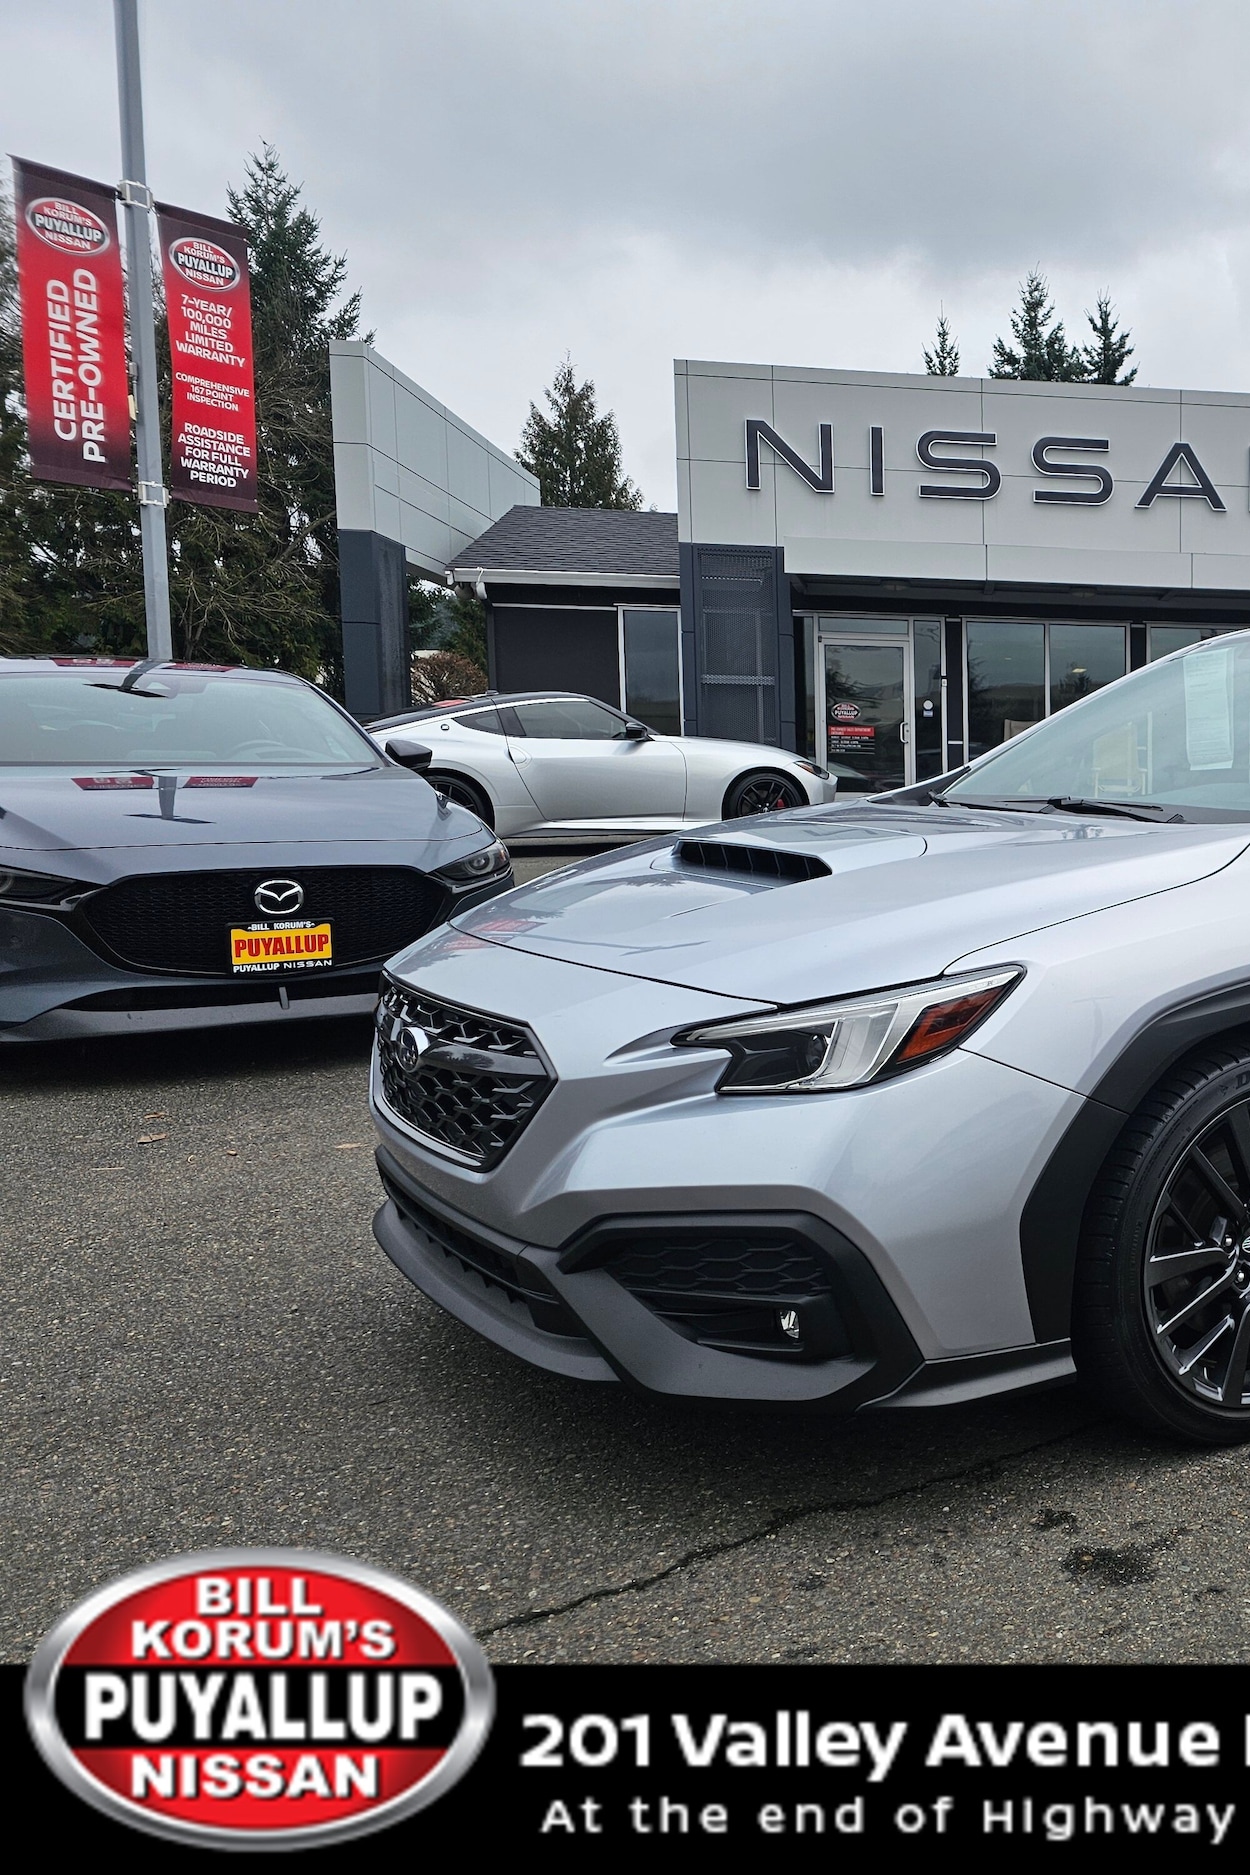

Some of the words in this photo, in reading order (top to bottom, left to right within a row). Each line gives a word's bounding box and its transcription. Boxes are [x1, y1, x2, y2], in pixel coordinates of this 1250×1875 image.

[43, 207, 92, 226] KORUM'S
[54, 201, 79, 215] BILL
[35, 213, 102, 241] PUYALLUP
[44, 230, 91, 249] NISSAN
[193, 242, 213, 253] BILL
[177, 253, 234, 278] PUYALLUP
[184, 246, 225, 264] KORUM'S
[185, 269, 224, 286] NISSAN
[181, 294, 232, 317] 7-YEAR/
[181, 306, 231, 329] 100,000
[190, 321, 227, 340] MILES
[185, 331, 234, 352] LIMITED
[47, 279, 76, 441] CERTIFIED
[176, 340, 245, 368] WARRANTY
[73, 268, 106, 463] PRE-OWNED
[175, 372, 250, 397] COMPREHENSIVE
[190, 385, 203, 394] 167
[205, 389, 233, 401] POINT
[187, 392, 239, 412] INSPECTION
[184, 422, 244, 444] ROADSIDE
[178, 433, 251, 457] ASSISTANCE
[185, 446, 209, 460] FOR
[211, 452, 242, 467] FULL
[181, 456, 249, 479] WARRANTY
[190, 470, 236, 488] PERIOD
[235, 934, 328, 958] PUYALLUP
[233, 962, 280, 973] PUYALLUP
[283, 960, 332, 969] NISSAN
